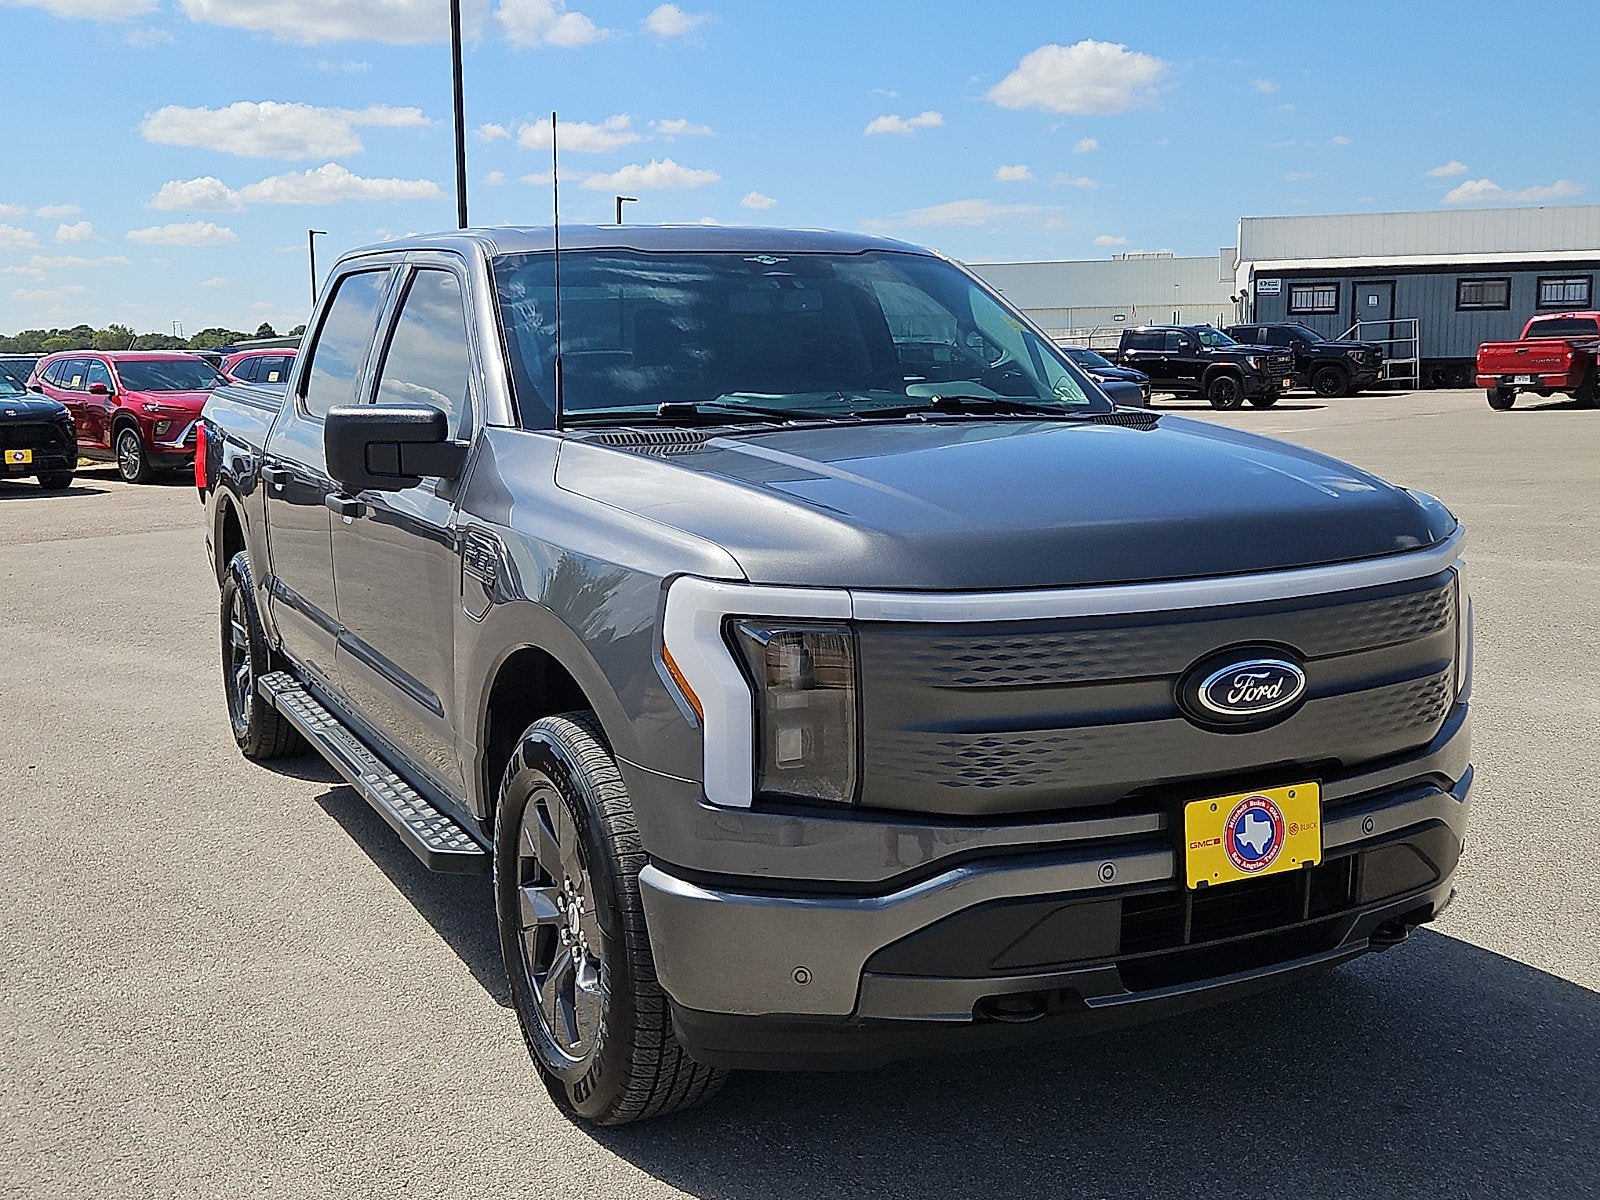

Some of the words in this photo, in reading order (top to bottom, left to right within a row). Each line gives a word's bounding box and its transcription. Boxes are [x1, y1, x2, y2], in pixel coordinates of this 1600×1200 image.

[1227, 672, 1283, 704] Ford
[1228, 804, 1248, 829] Mitchell
[1249, 800, 1266, 808] Buick
[1269, 807, 1280, 822] GMC
[1300, 822, 1318, 831] BUICK
[1190, 838, 1213, 849] GMC
[1231, 851, 1242, 865] San
[1241, 860, 1265, 870] Angelo,
[1265, 845, 1279, 863] Texas
